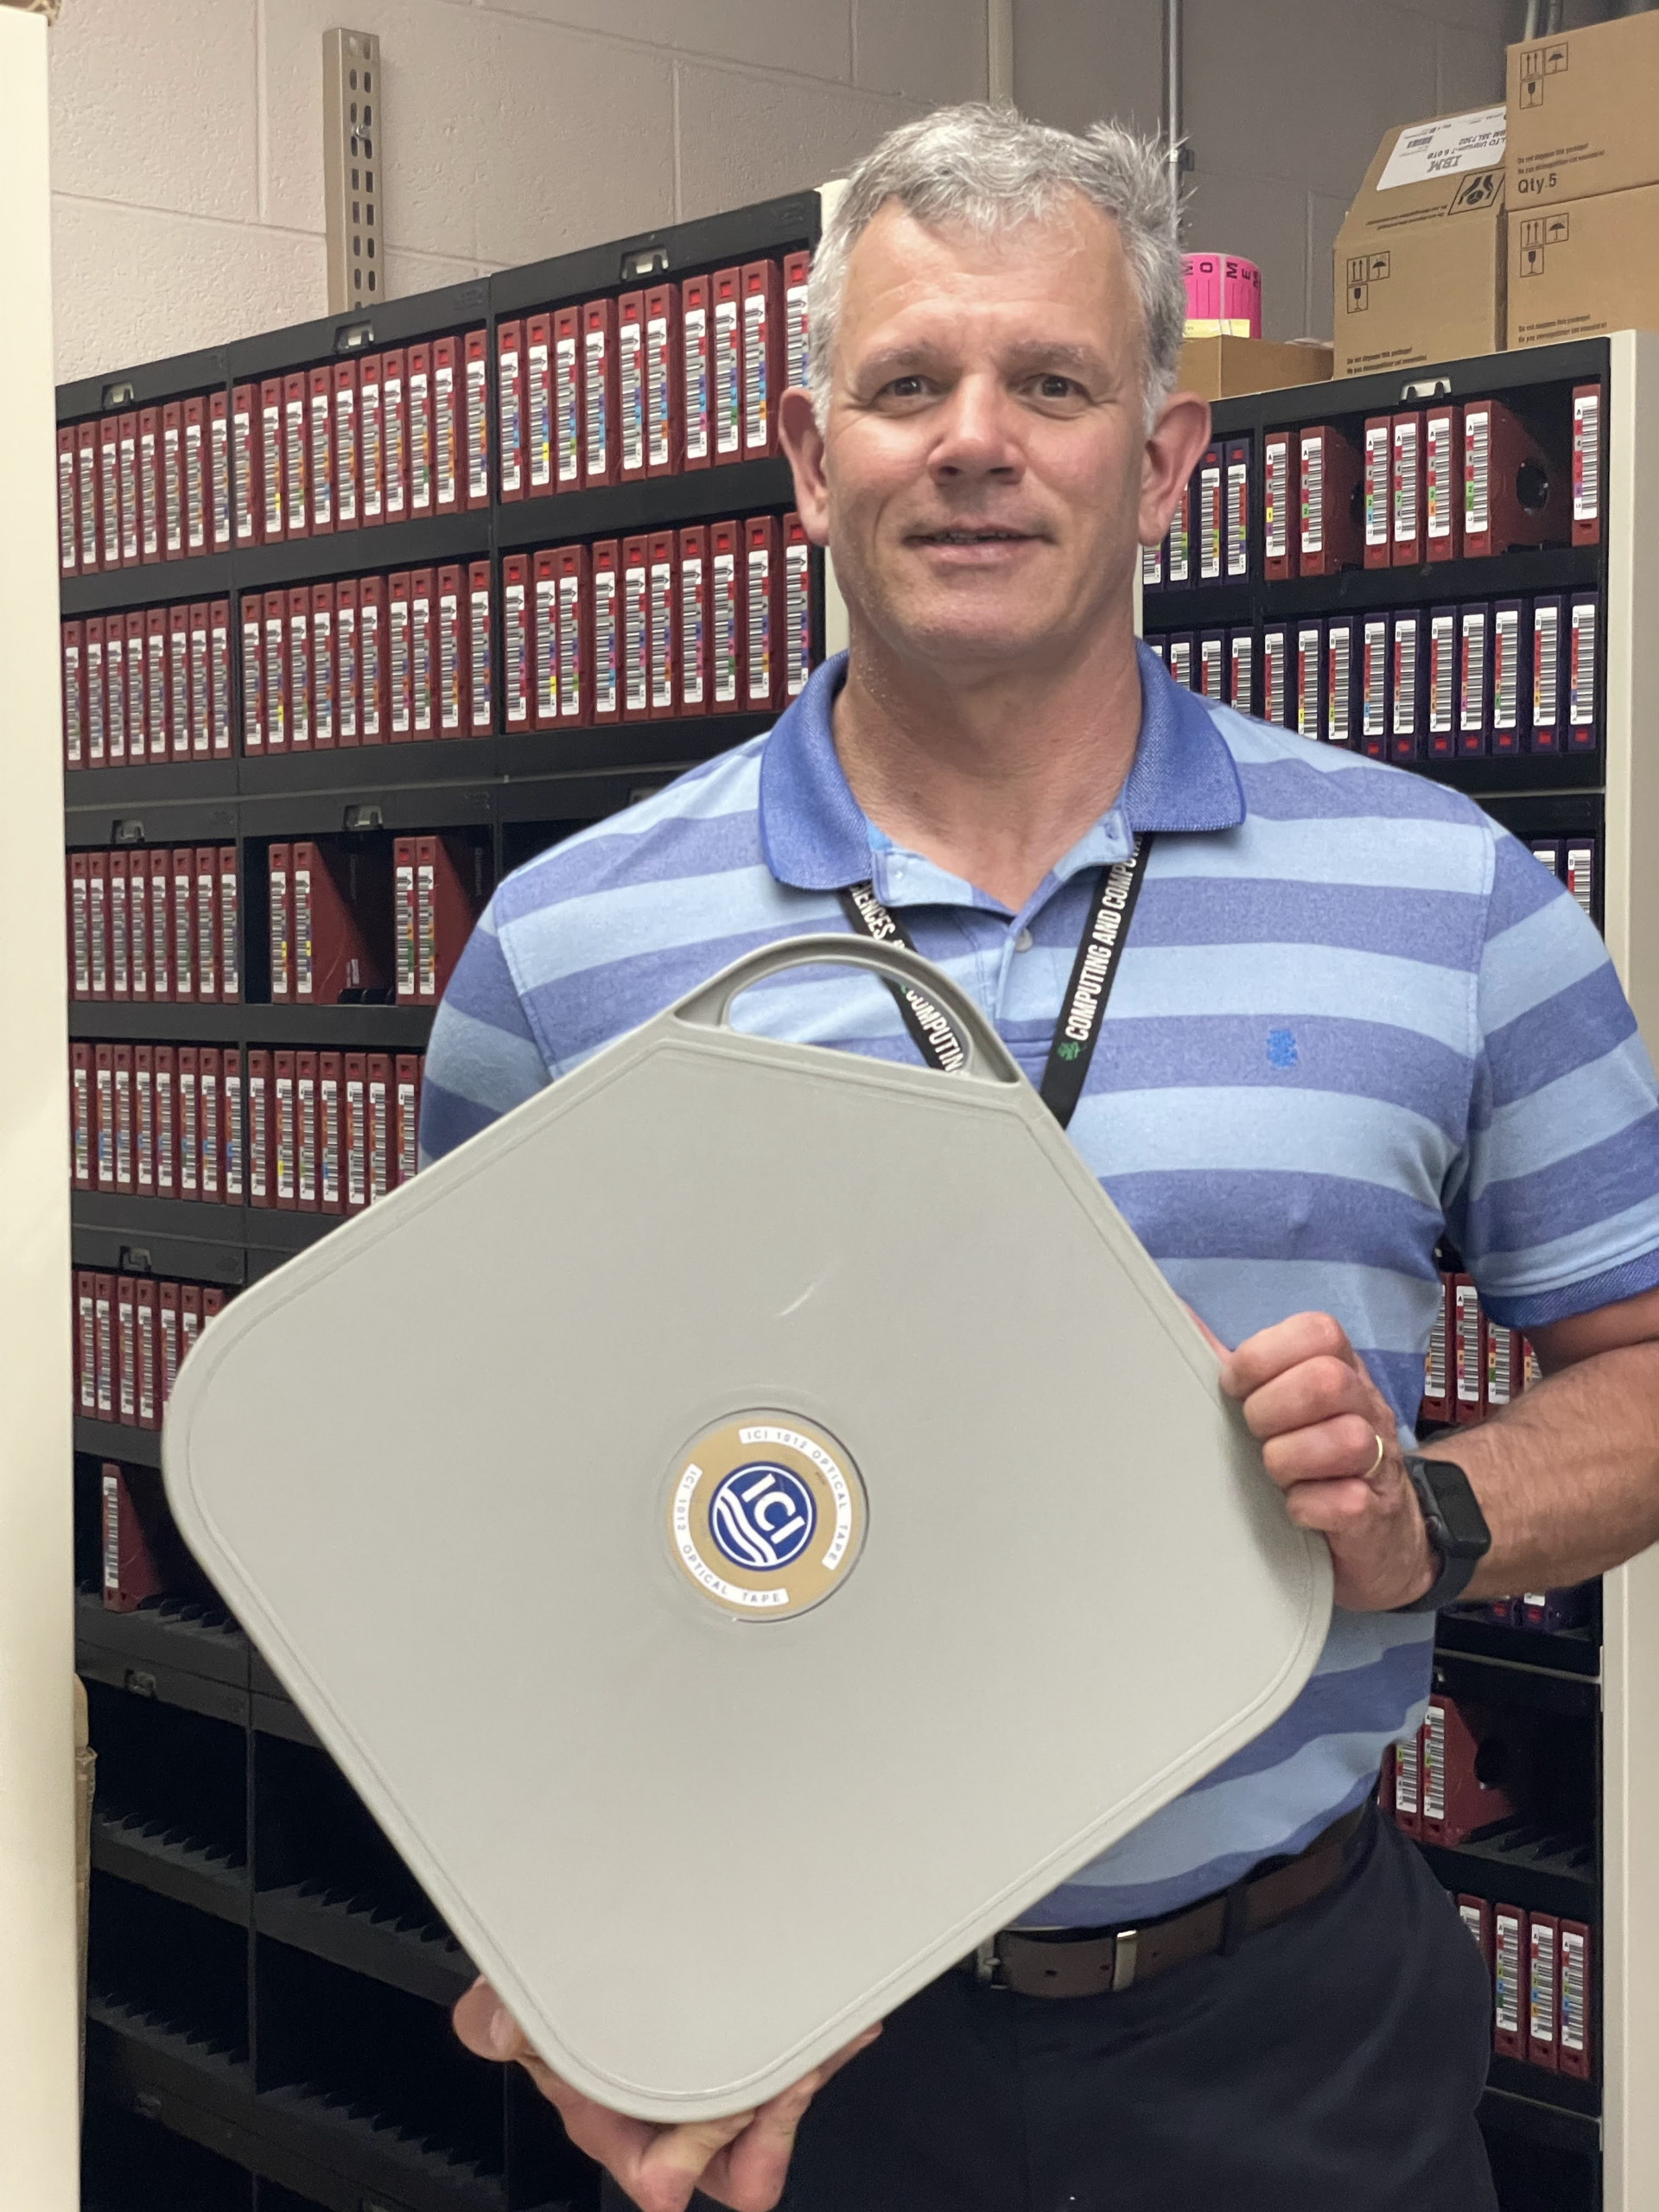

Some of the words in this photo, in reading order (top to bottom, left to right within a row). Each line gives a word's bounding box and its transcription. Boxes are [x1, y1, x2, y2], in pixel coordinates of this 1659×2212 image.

[1427, 155, 1462, 173] IBM
[1065, 944, 1112, 1041] COMPUTING
[1092, 909, 1122, 947] AND
[747, 1430, 768, 1440] ICI
[777, 1432, 807, 1449] 1012
[682, 1471, 697, 1490] ICI
[812, 1449, 848, 1510] OPTICAL
[741, 1473, 805, 1544] ICI
[828, 1525, 848, 1561] TAPE
[683, 1544, 728, 1595] OPTICAL
[742, 1592, 781, 1603] TAPE
